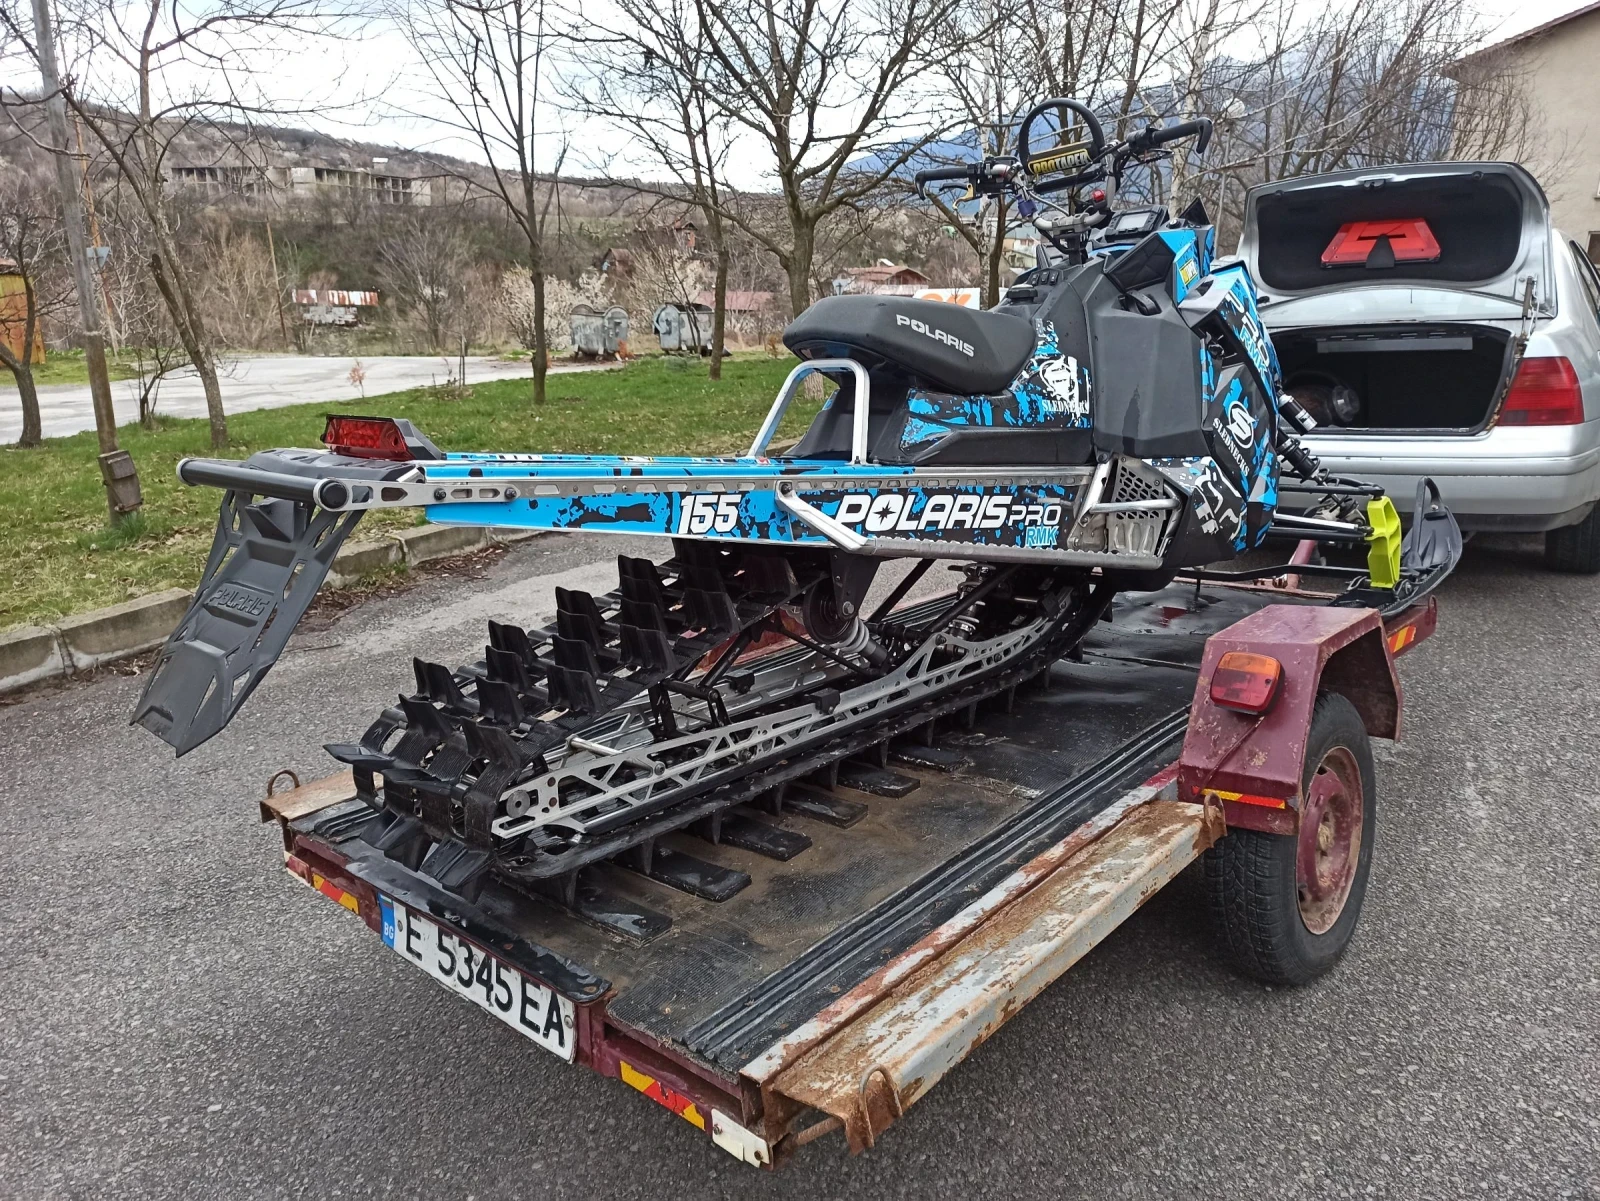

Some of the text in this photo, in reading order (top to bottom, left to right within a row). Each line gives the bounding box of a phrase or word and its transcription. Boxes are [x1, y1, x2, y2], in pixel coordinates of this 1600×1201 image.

[896, 313, 975, 357] POLARIS
[1212, 417, 1250, 477] SLEDNECKS
[678, 494, 742, 535] 155
[834, 494, 1062, 532] POLARIS PRO
[1025, 525, 1059, 547] RMK
[209, 588, 271, 617] POLARIS
[383, 921, 394, 940] BG
[405, 906, 566, 1049] E 5345 EA
